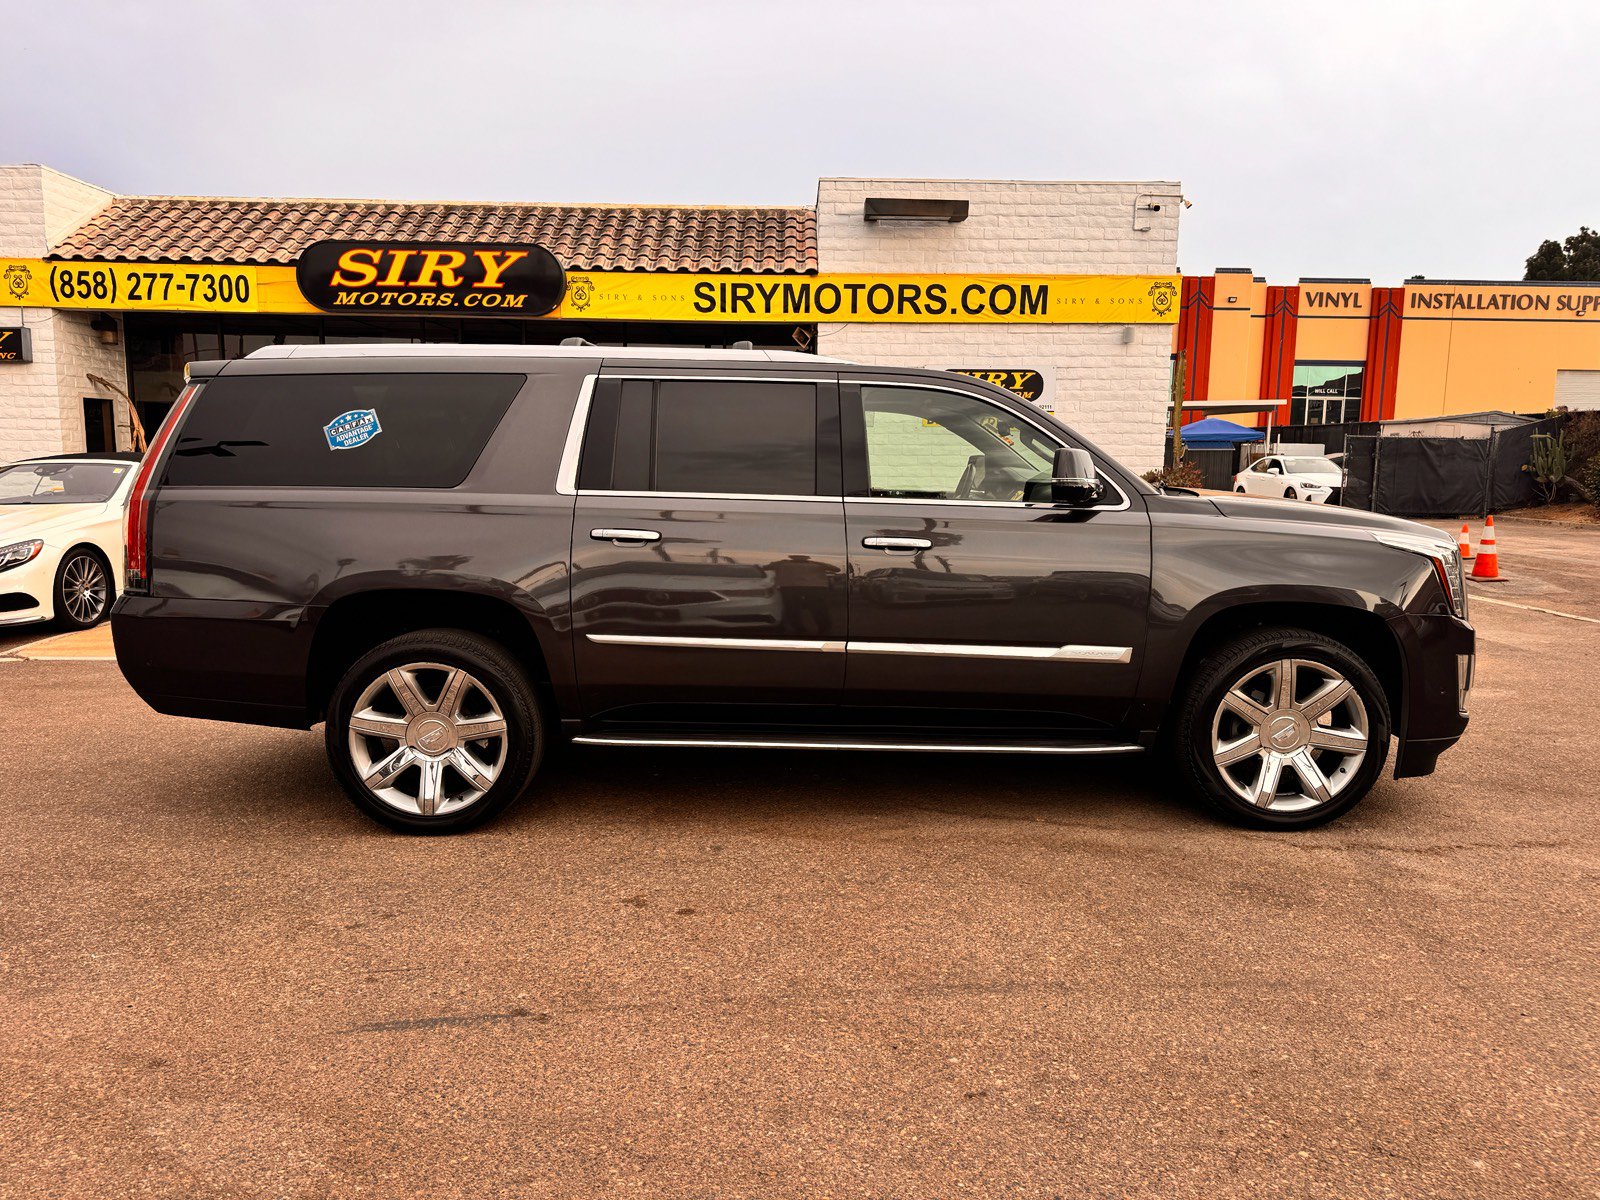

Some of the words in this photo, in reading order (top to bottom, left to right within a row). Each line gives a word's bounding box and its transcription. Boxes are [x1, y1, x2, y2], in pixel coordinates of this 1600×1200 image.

[329, 248, 529, 289] SIRY
[50, 265, 117, 303] (858)
[126, 272, 250, 303] 277-7300
[333, 291, 528, 308] MOTORS.COM
[598, 293, 628, 301] SIRY
[652, 294, 686, 302] SONS
[693, 281, 1048, 315] SIRYMOTORS.COM
[1056, 297, 1085, 305] SIRY
[1110, 297, 1143, 305] SONS
[1305, 291, 1362, 309] VINYL
[1410, 292, 1550, 311] INSTALLATION
[330, 416, 373, 435] CARFAX
[336, 425, 373, 442] ADVANTAGE
[343, 432, 369, 446] DEALER
